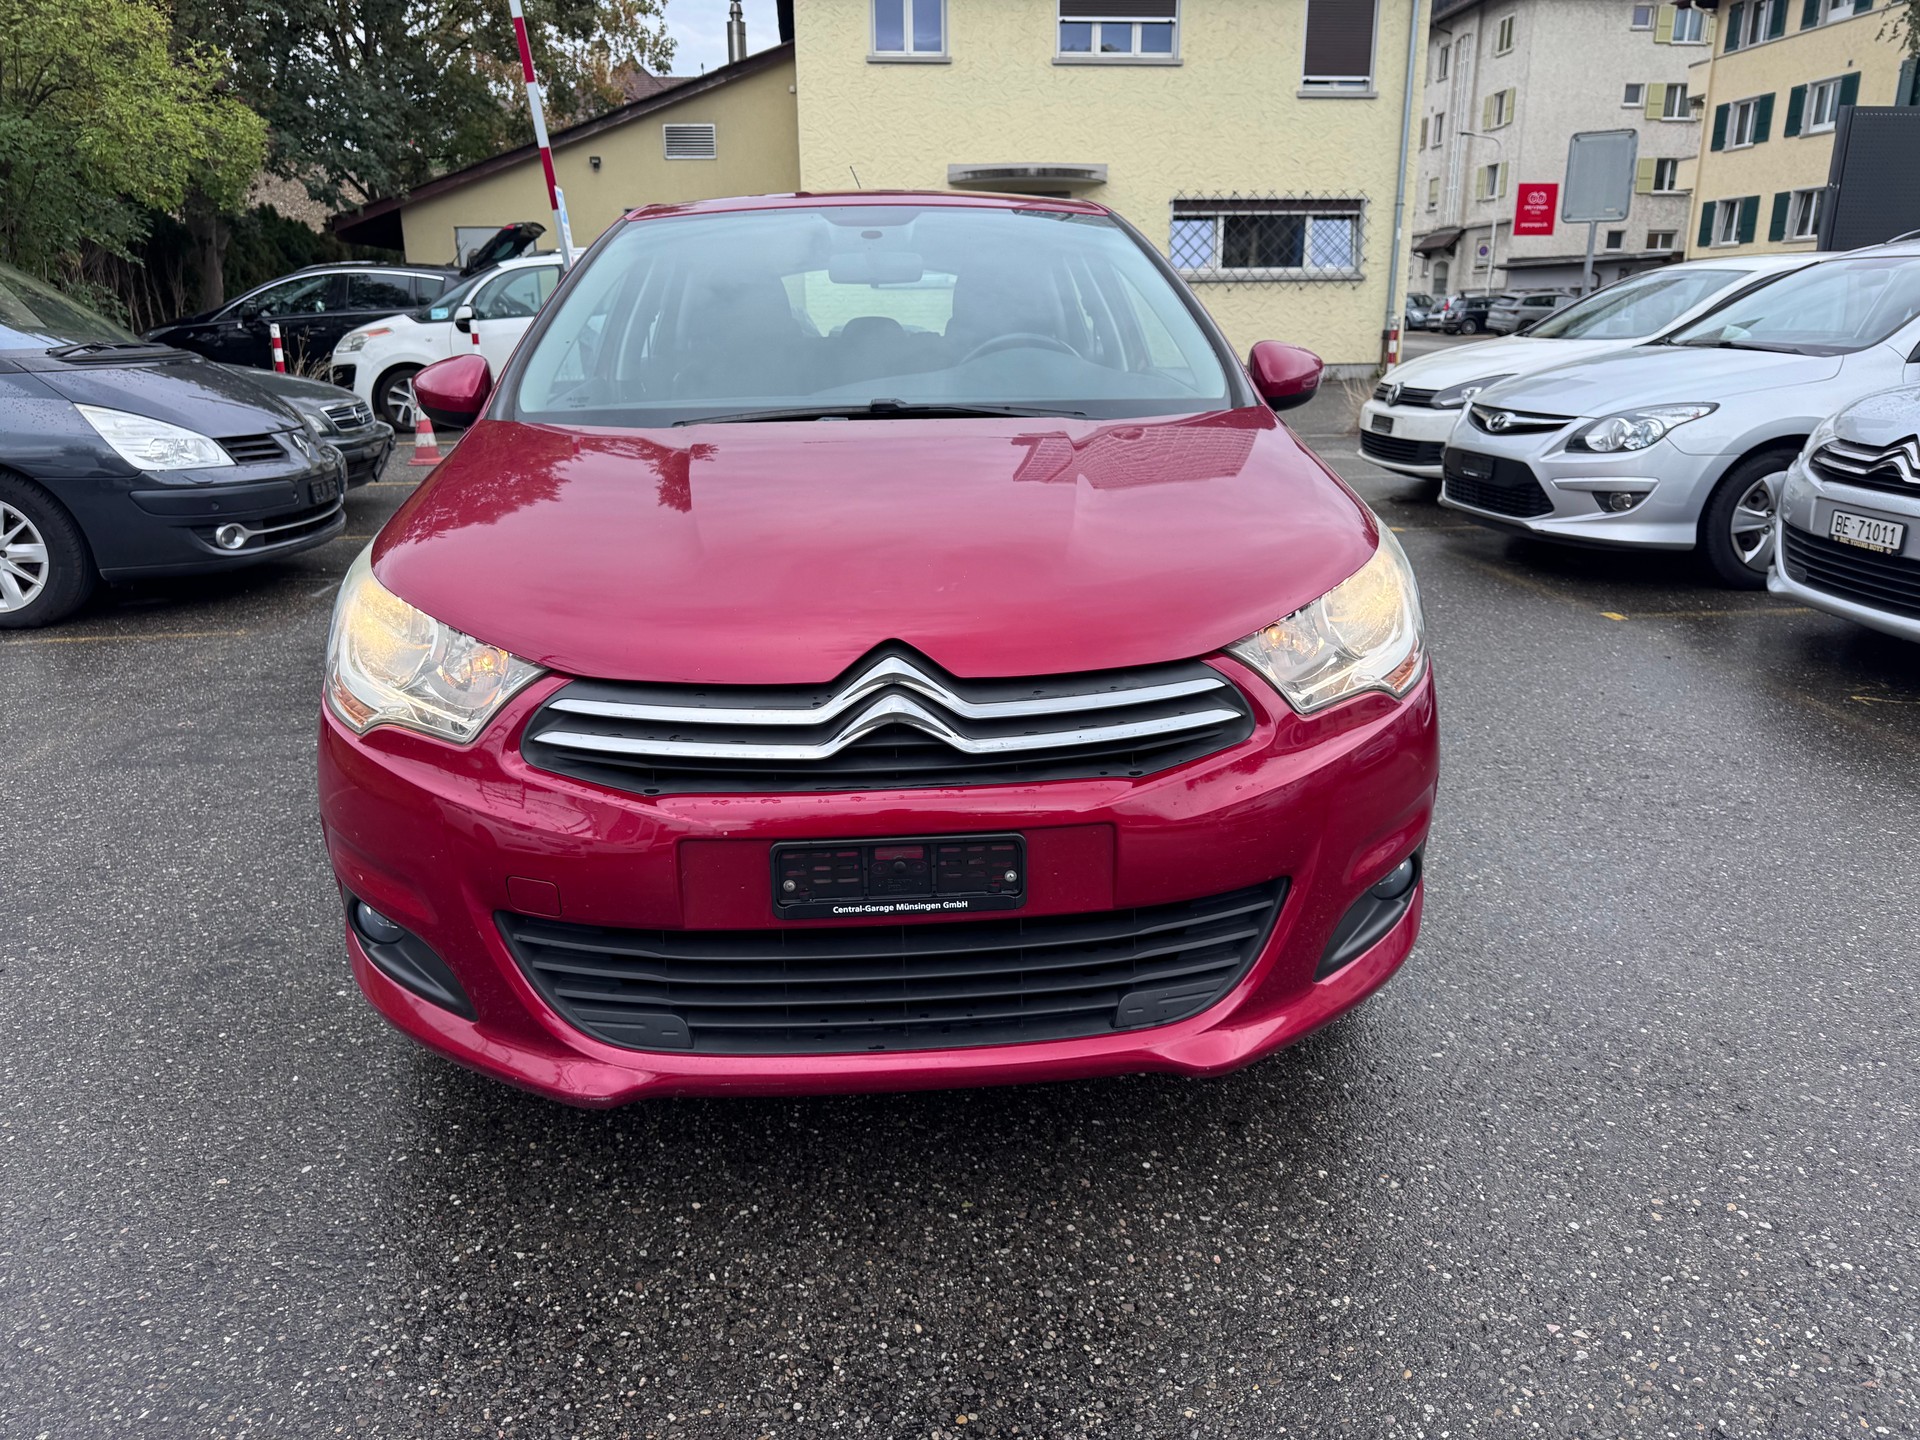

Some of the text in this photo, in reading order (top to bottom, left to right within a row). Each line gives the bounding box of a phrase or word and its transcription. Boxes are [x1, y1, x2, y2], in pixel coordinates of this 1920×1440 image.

[833, 900, 968, 913] Central-Garage Münsingen GmbH
